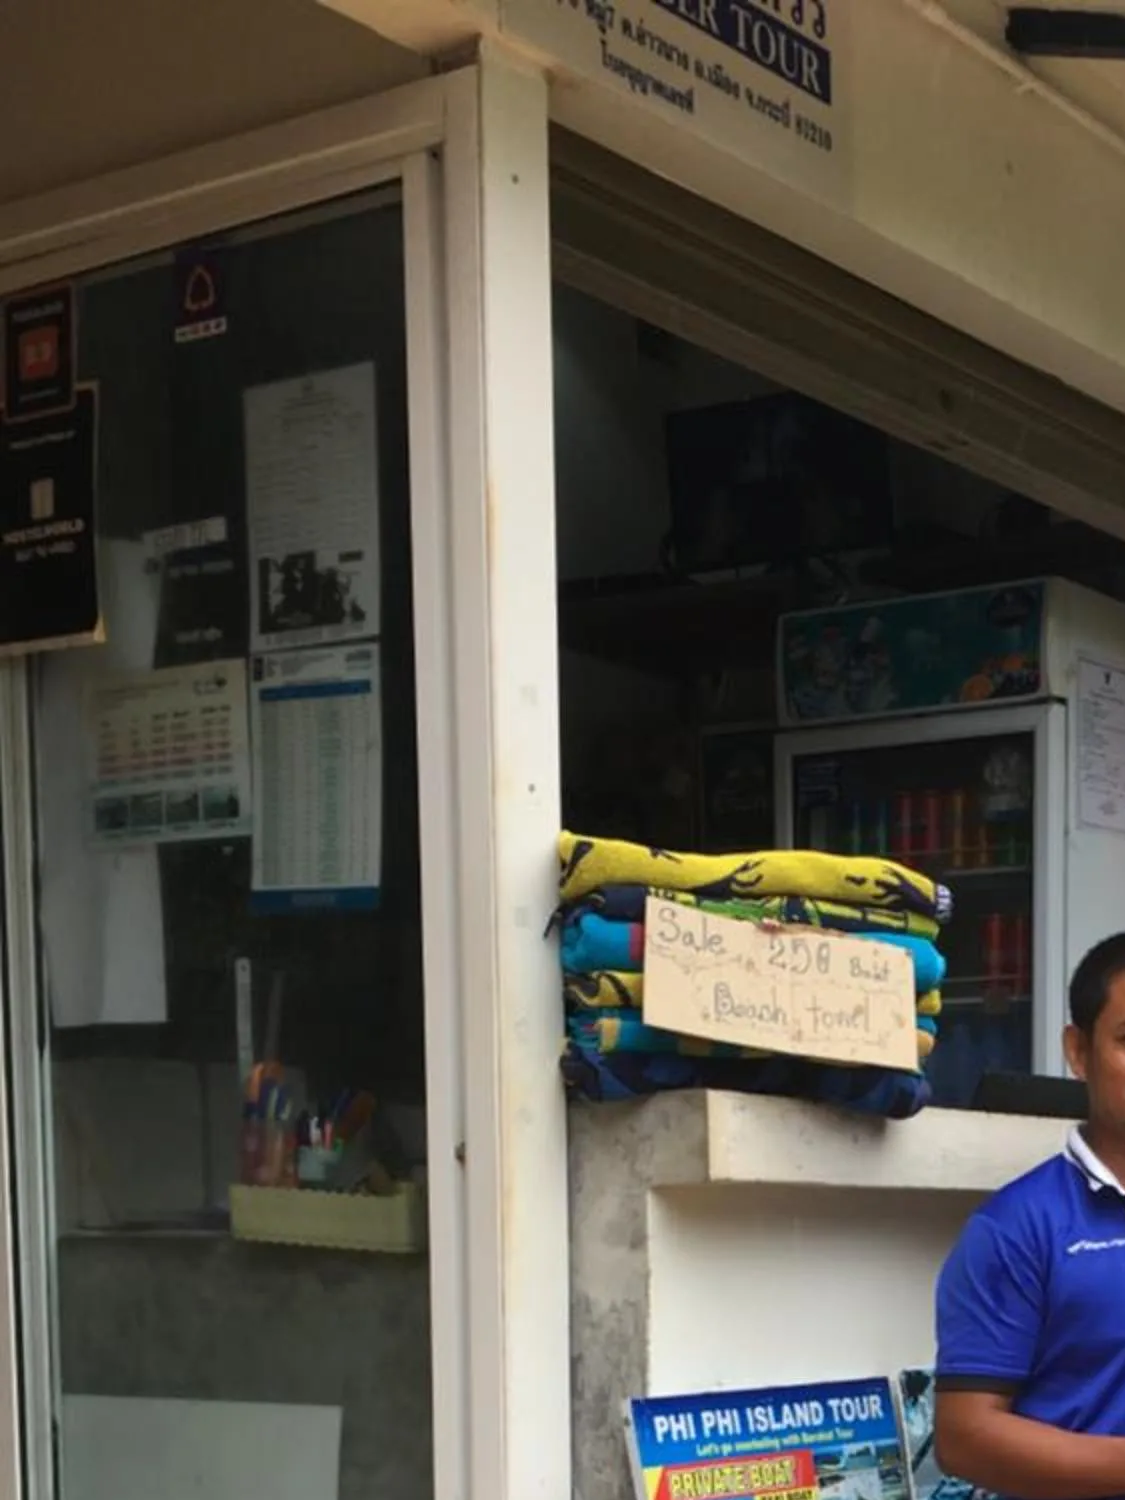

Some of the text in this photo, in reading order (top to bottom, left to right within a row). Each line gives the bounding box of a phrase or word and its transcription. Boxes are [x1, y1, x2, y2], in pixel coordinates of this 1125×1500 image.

[731, 4, 822, 96] TOUR
[654, 1394, 885, 1443] PHI PHI ISLAND TOUR
[671, 1456, 795, 1500] PRIVATE BOAT
